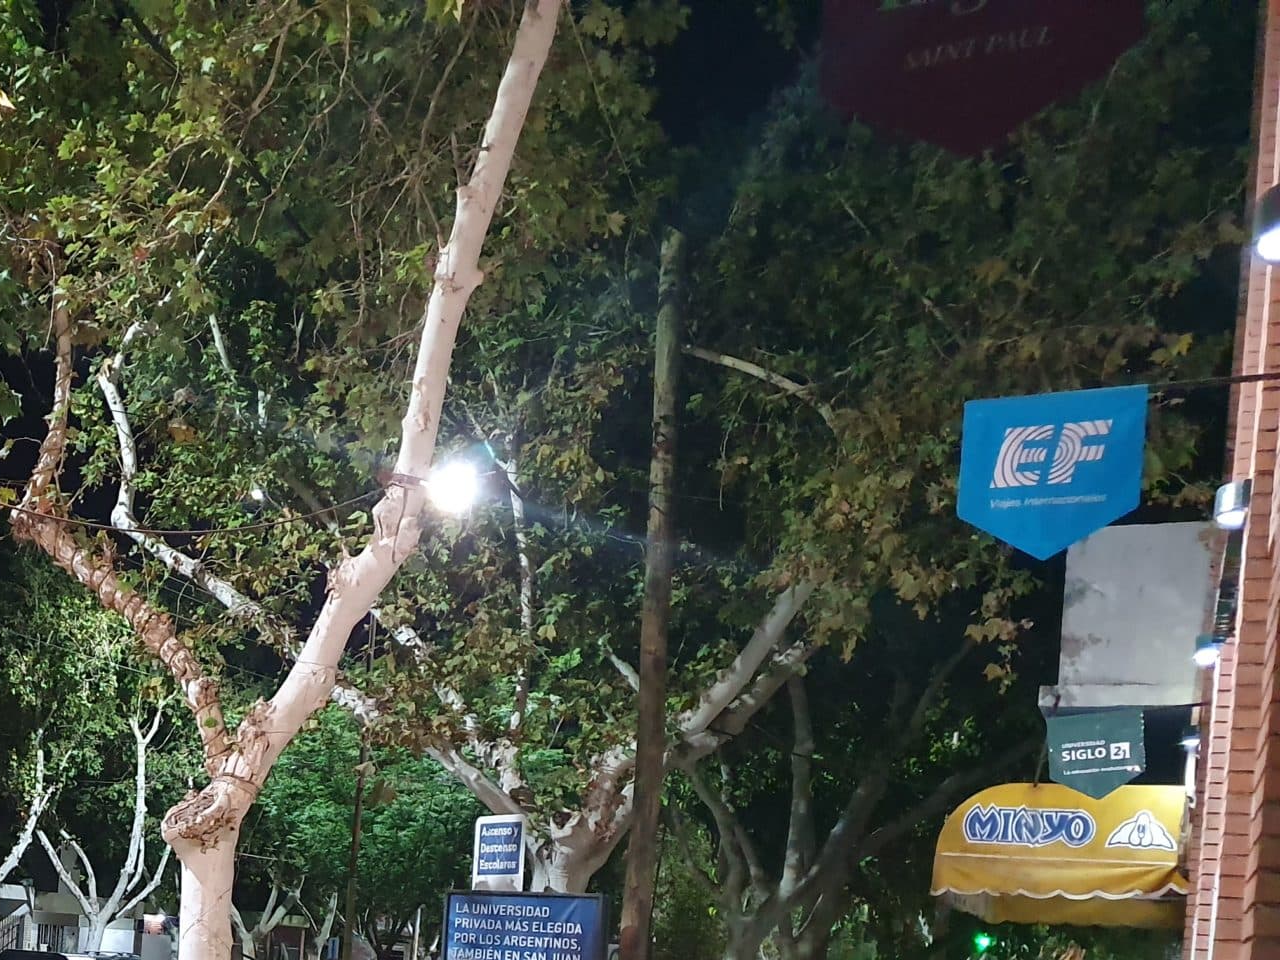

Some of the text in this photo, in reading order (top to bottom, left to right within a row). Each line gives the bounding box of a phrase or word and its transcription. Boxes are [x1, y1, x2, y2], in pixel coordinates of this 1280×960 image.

[904, 25, 1052, 71] SAINT PAUL
[989, 419, 1113, 488] EF
[1061, 743, 1130, 762] SIGLO 21
[481, 826, 519, 837] Ascenso y
[963, 804, 1095, 848] MINYO
[481, 843, 517, 853] Descenso
[480, 859, 516, 869] Escolares
[456, 903, 550, 918] LA UNIVERSIDAD
[454, 917, 583, 935] PRIVADA MÁS ELEGIDA
[454, 932, 581, 951] POR LOS ARGENTINOS,
[452, 946, 502, 960] TAMBIÉN
